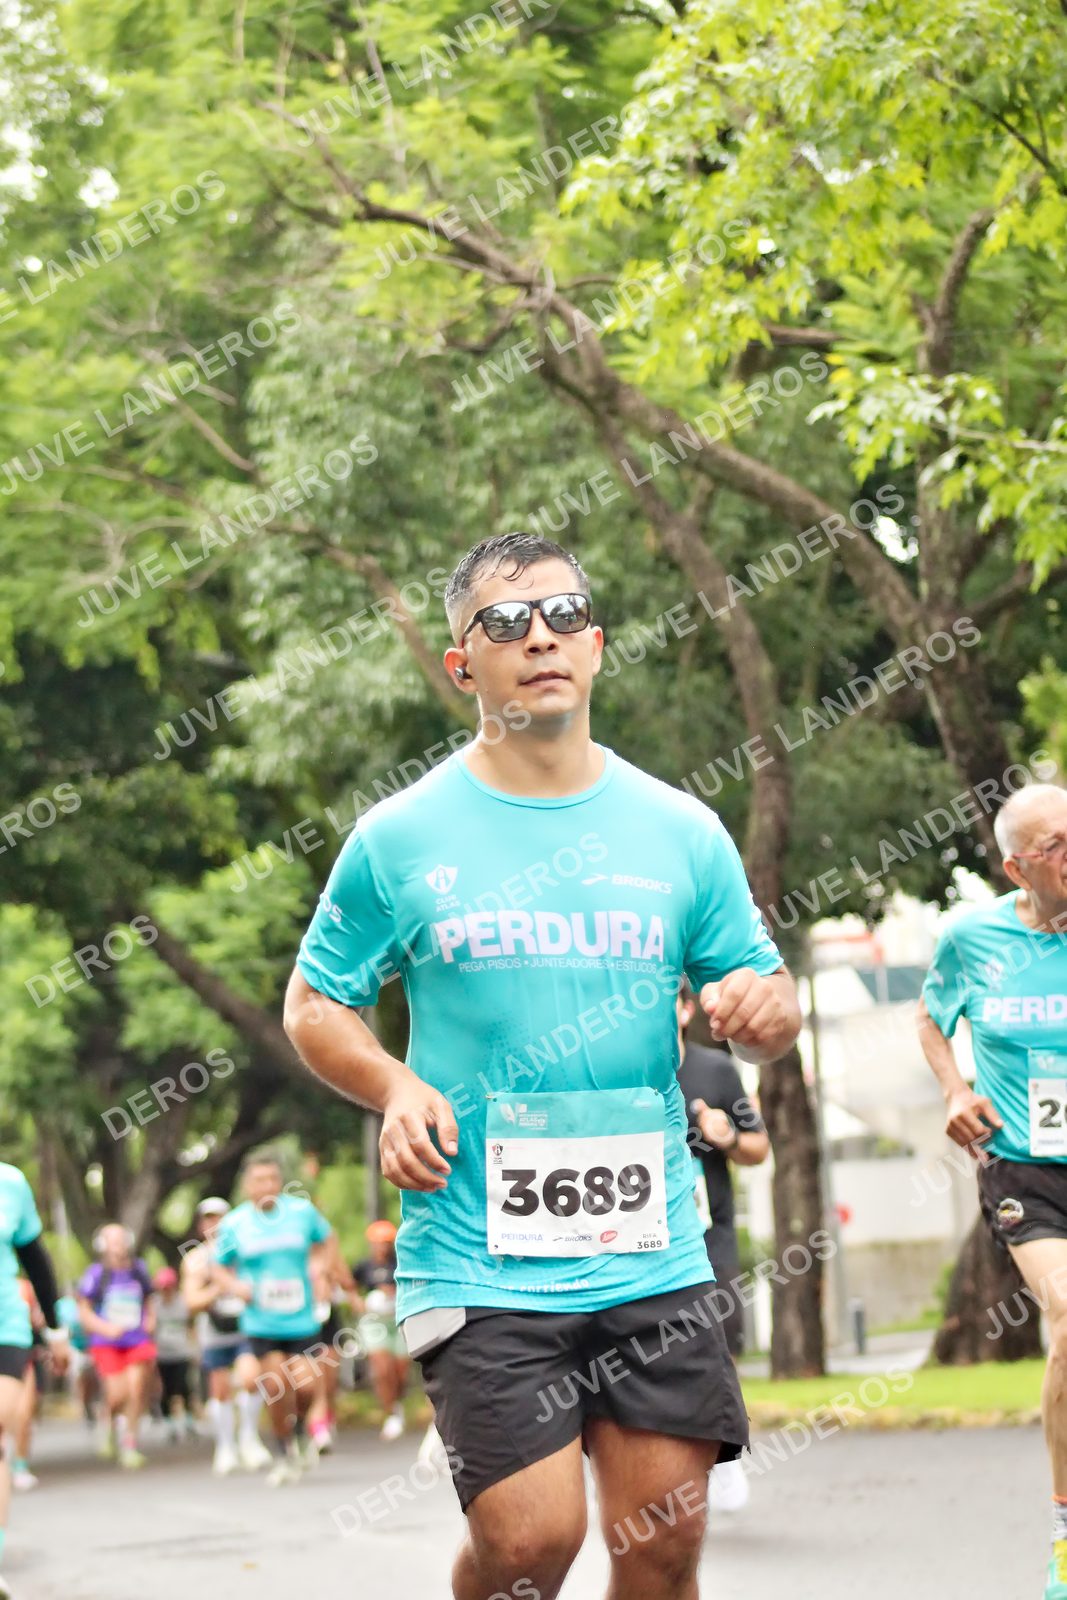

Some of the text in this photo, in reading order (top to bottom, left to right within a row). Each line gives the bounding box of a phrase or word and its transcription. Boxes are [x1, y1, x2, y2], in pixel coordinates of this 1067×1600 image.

[611, 874, 673, 894] BROOKS
[434, 909, 665, 963] PERDURA
[459, 957, 657, 974] PEGA PISOS JUNTEADORES ESTUCOS
[1038, 1098, 1067, 1129] 2
[501, 1164, 652, 1217] 3689
[501, 1233, 543, 1242] PERDURA
[636, 1240, 662, 1250] 3689
